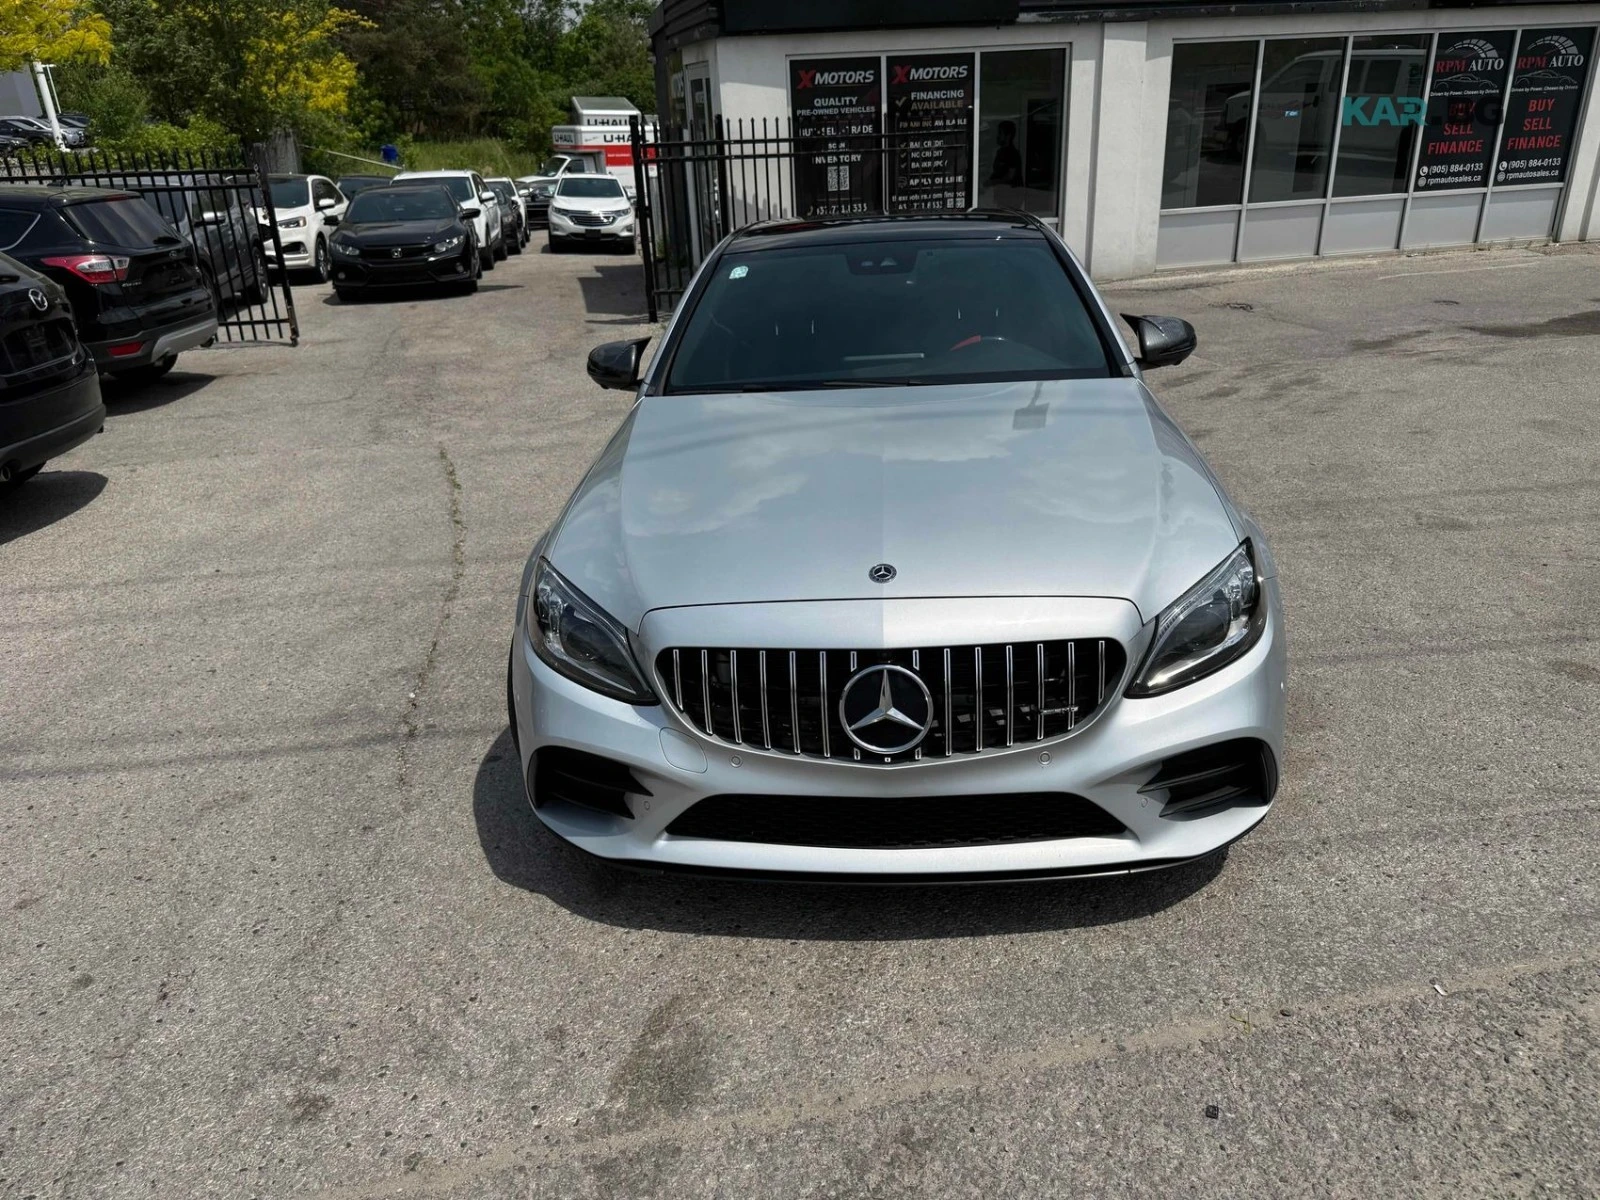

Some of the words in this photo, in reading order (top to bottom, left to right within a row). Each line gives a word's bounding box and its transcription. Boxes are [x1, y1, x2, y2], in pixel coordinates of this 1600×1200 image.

[1434, 56, 1466, 73] RPM
[1468, 58, 1504, 73] AUTO
[1516, 54, 1549, 69] RPM
[1549, 54, 1584, 68] AUTO
[911, 90, 964, 100] FINANCING
[814, 96, 858, 107] QUALITY
[911, 99, 963, 110] AVAILABLE
[1528, 98, 1555, 112] BUY
[797, 108, 839, 117] PRE-OWNED
[840, 105, 876, 114] VEHICLES
[586, 118, 628, 126] U-HAU
[1523, 117, 1552, 131] SELL
[1443, 122, 1473, 136] SELL
[923, 140, 944, 148] CRDIT
[1428, 139, 1484, 155] FINANCE
[1507, 135, 1562, 150] FINANCE
[1429, 164, 1448, 175] (905)
[1449, 163, 1484, 173] 884-0133
[1508, 159, 1527, 170] (905)
[1528, 157, 1561, 168] 884-0133
[1427, 174, 1482, 185] rpmautosales.ca
[1506, 169, 1559, 180] rpmautosales.ca
